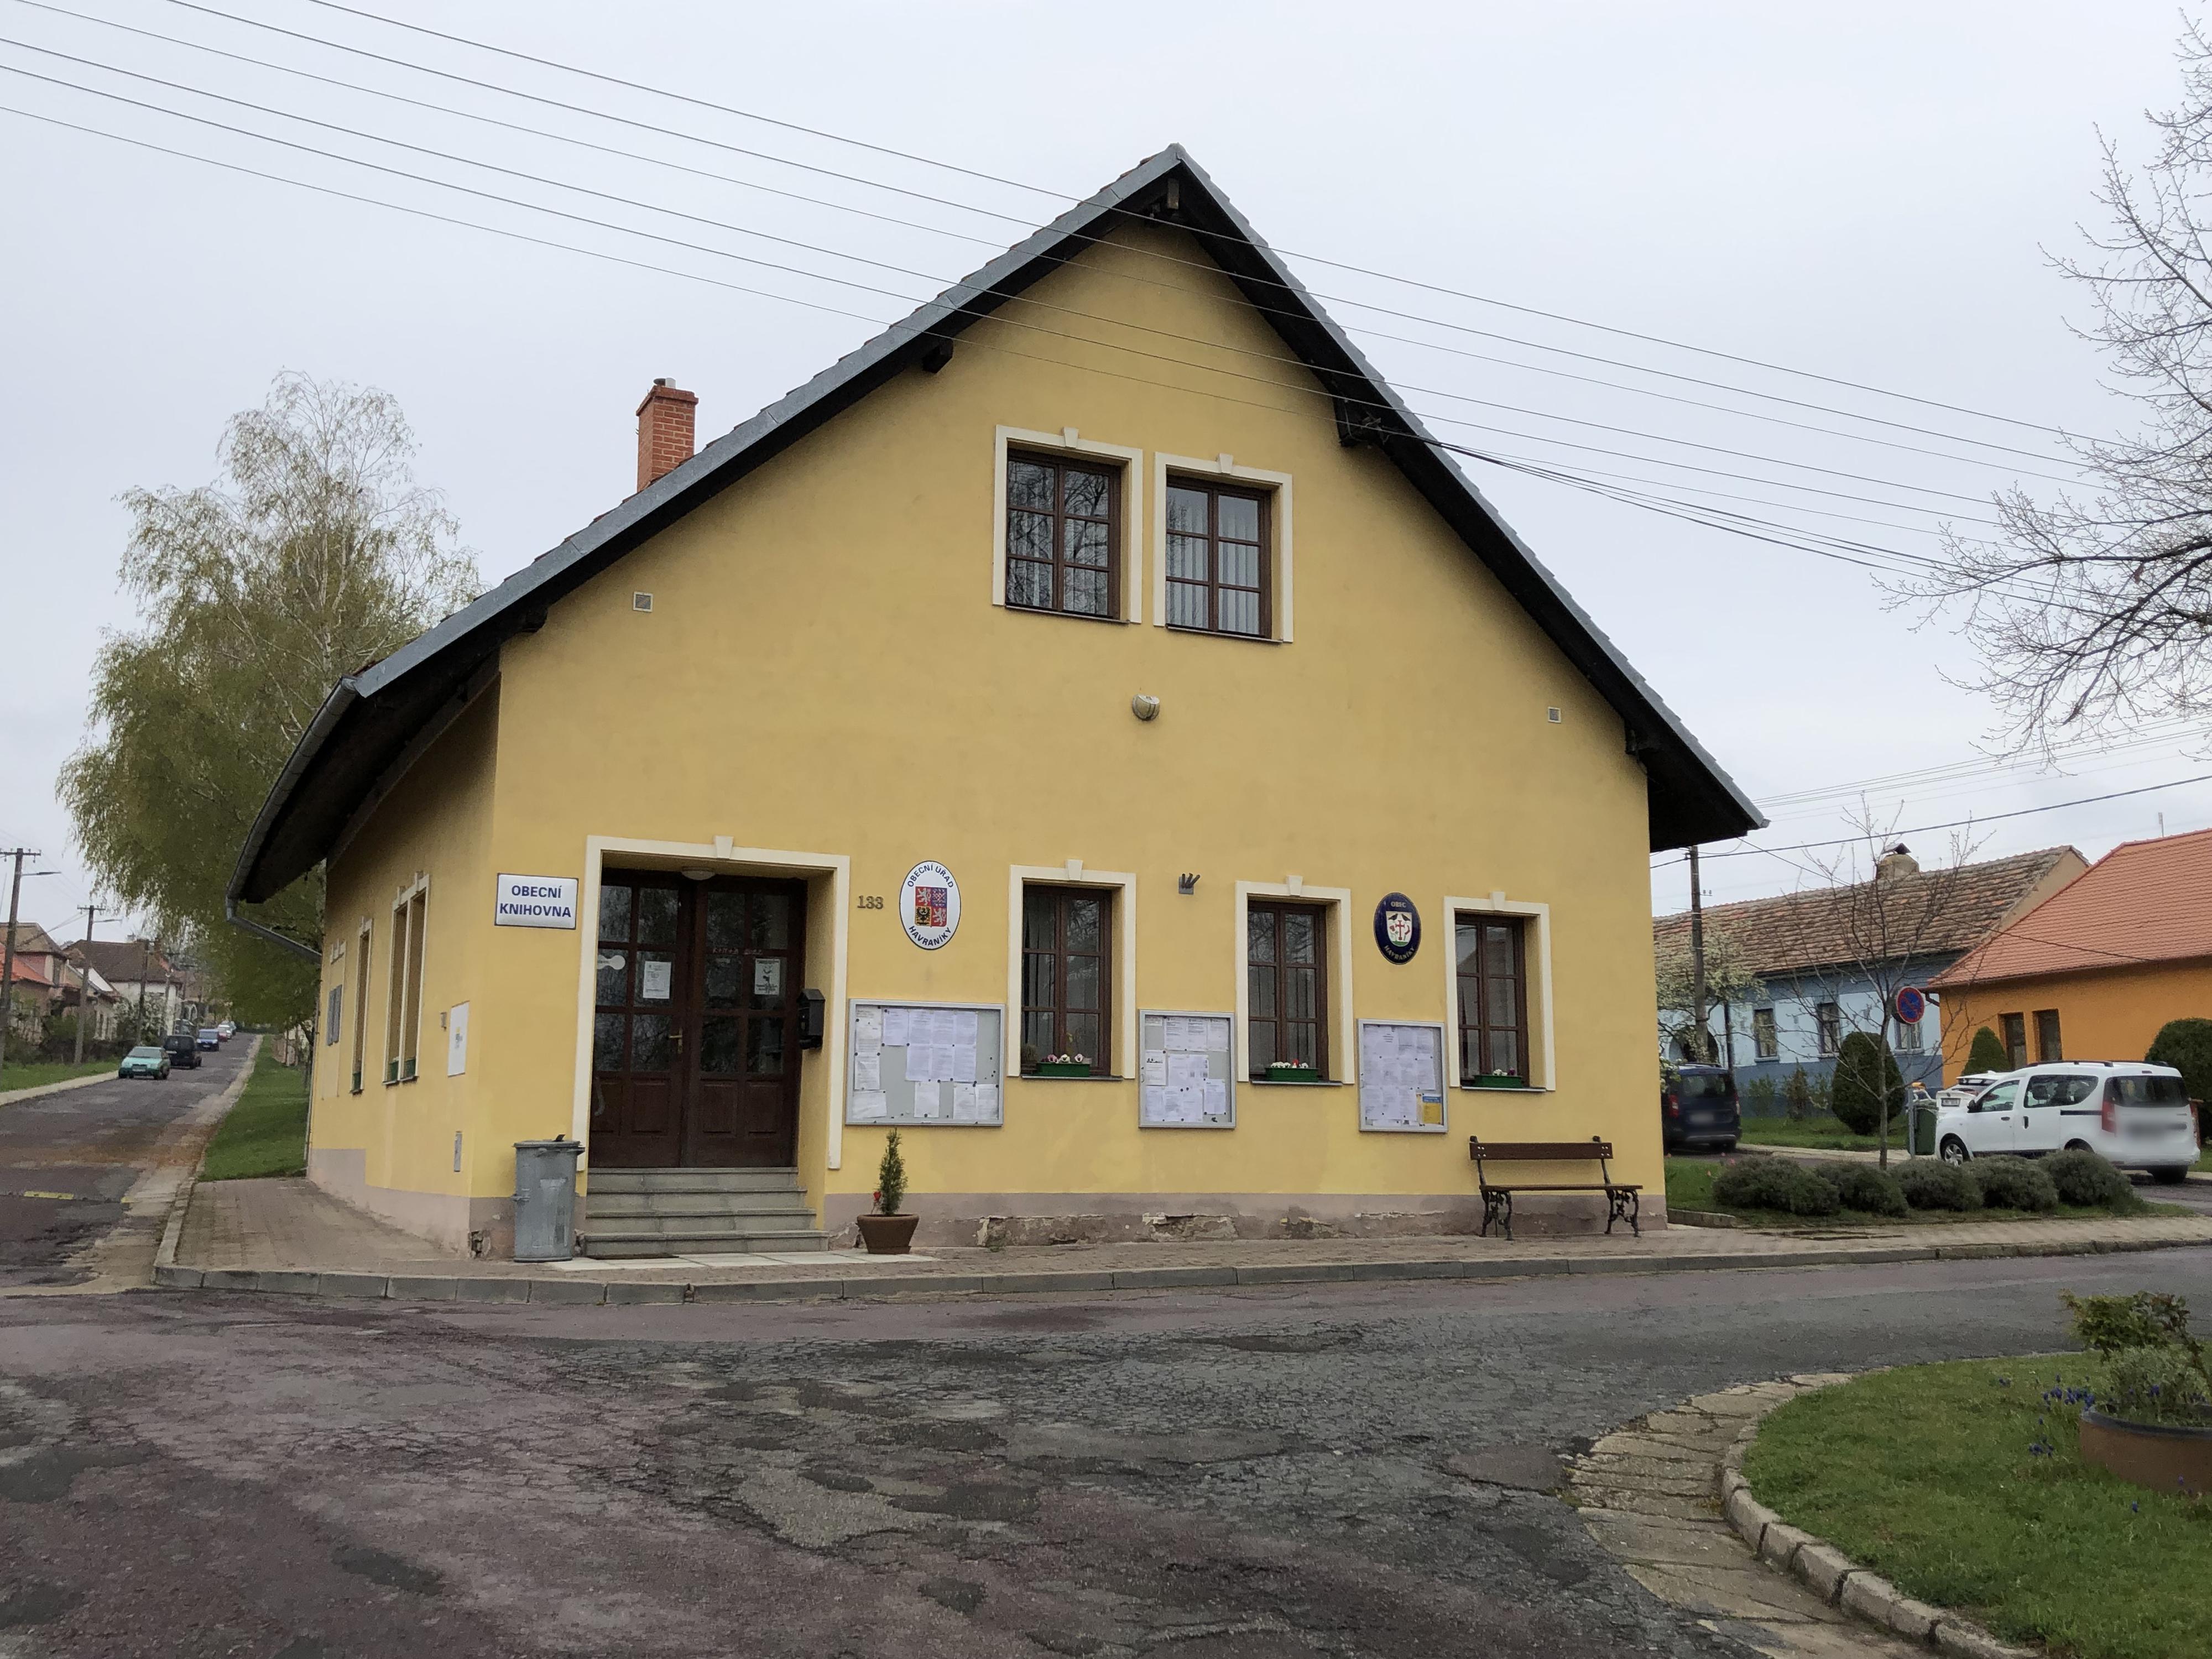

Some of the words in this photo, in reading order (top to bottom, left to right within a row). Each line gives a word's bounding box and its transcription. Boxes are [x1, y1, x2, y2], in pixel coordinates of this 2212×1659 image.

[907, 864, 933, 887] OBECNÍ
[935, 865, 954, 888] ÚŘAD
[512, 885, 562, 898] OBECNÍ
[857, 895, 884, 910] 133
[499, 903, 572, 918] KNIHOVNA
[909, 925, 952, 946] HAVRANÍKY
